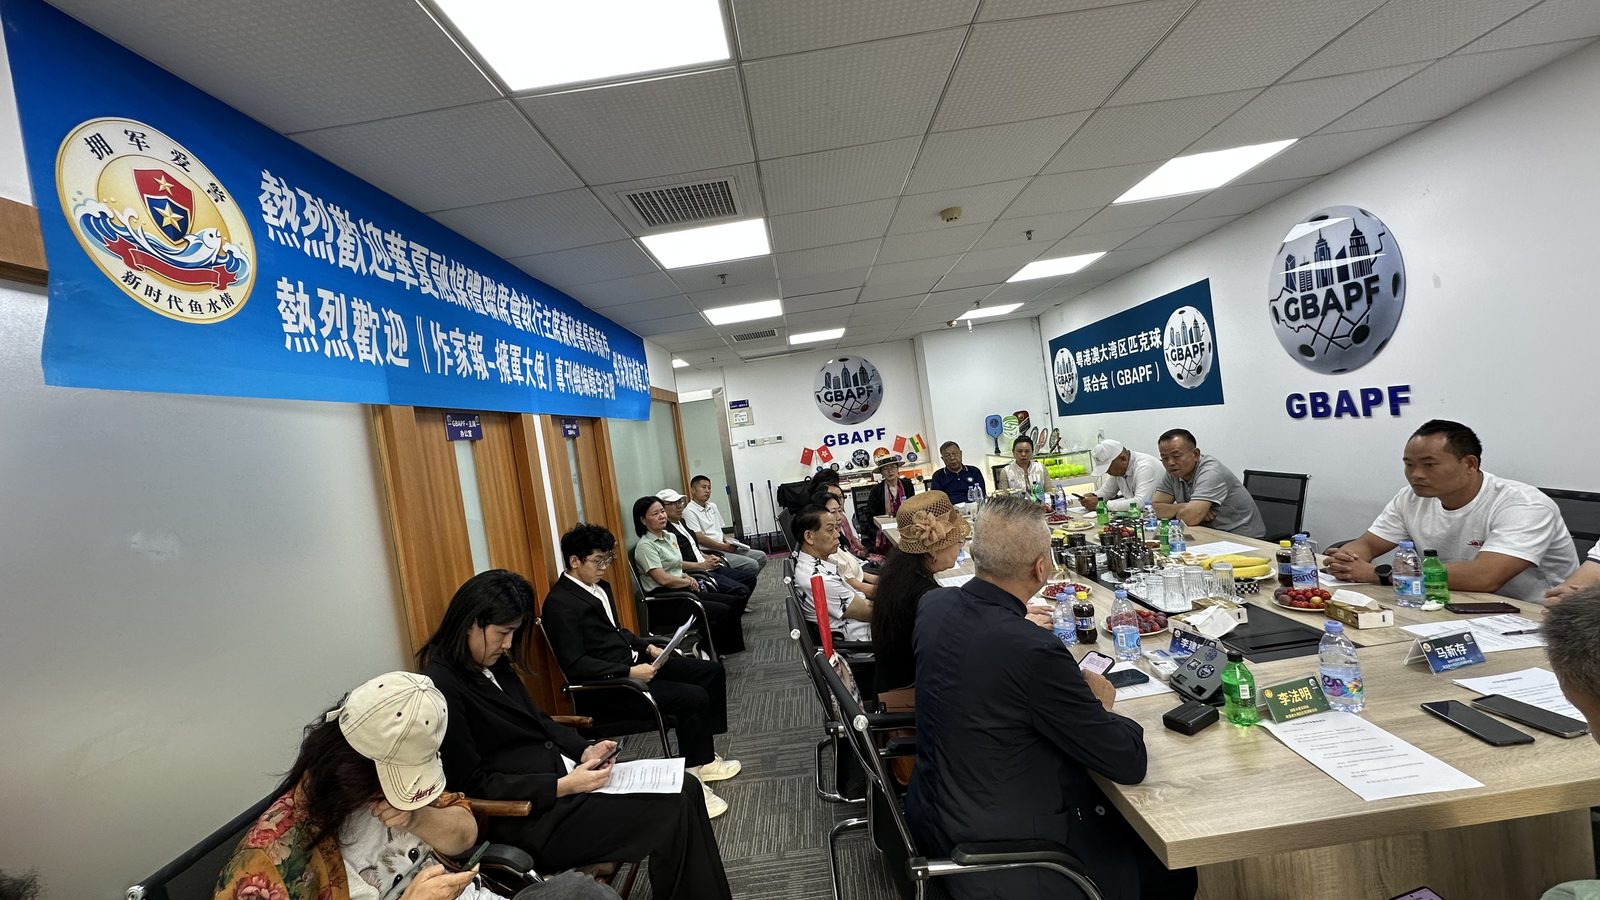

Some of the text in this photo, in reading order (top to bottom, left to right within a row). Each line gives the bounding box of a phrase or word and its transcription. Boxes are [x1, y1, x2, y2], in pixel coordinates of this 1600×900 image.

[121, 269, 235, 316] 新时代鱼水情
[1283, 274, 1380, 322] GBAPF
[1075, 327, 1163, 368] 粤港澳大湾区匹克球
[1170, 342, 1205, 362] GBAPF
[1056, 372, 1075, 385] GBAPF
[823, 384, 874, 403] GBAPF
[1285, 384, 1412, 420] GBAPF
[823, 427, 886, 448] GBAPF
[1435, 642, 1468, 659] 马新存
[1276, 686, 1313, 706] 李法明
